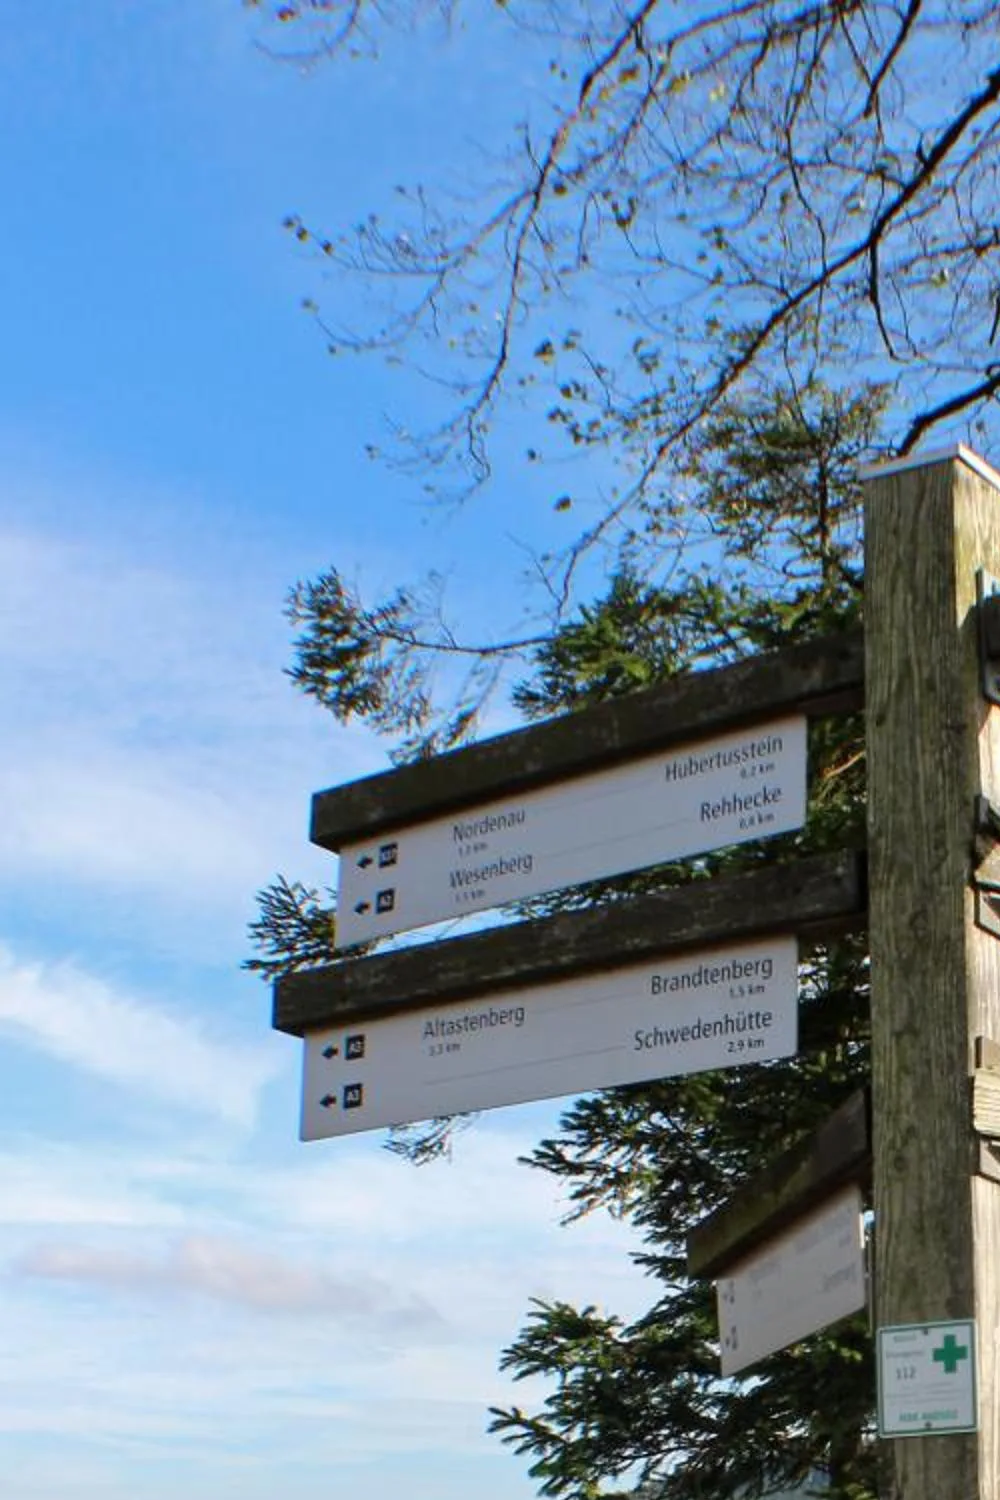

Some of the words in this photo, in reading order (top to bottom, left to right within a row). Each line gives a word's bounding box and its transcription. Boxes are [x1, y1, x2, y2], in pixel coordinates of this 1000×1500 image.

[665, 736, 783, 781] Hubertusstein
[701, 786, 781, 822] Rehhecke
[453, 809, 525, 843] Nordenau
[450, 854, 533, 889] Wesenberg
[651, 958, 773, 995] Brandtenberg
[748, 983, 765, 995] km
[424, 1008, 524, 1038] Altastenberg
[634, 1011, 773, 1051] Schwedenhütte
[747, 1037, 765, 1048] km
